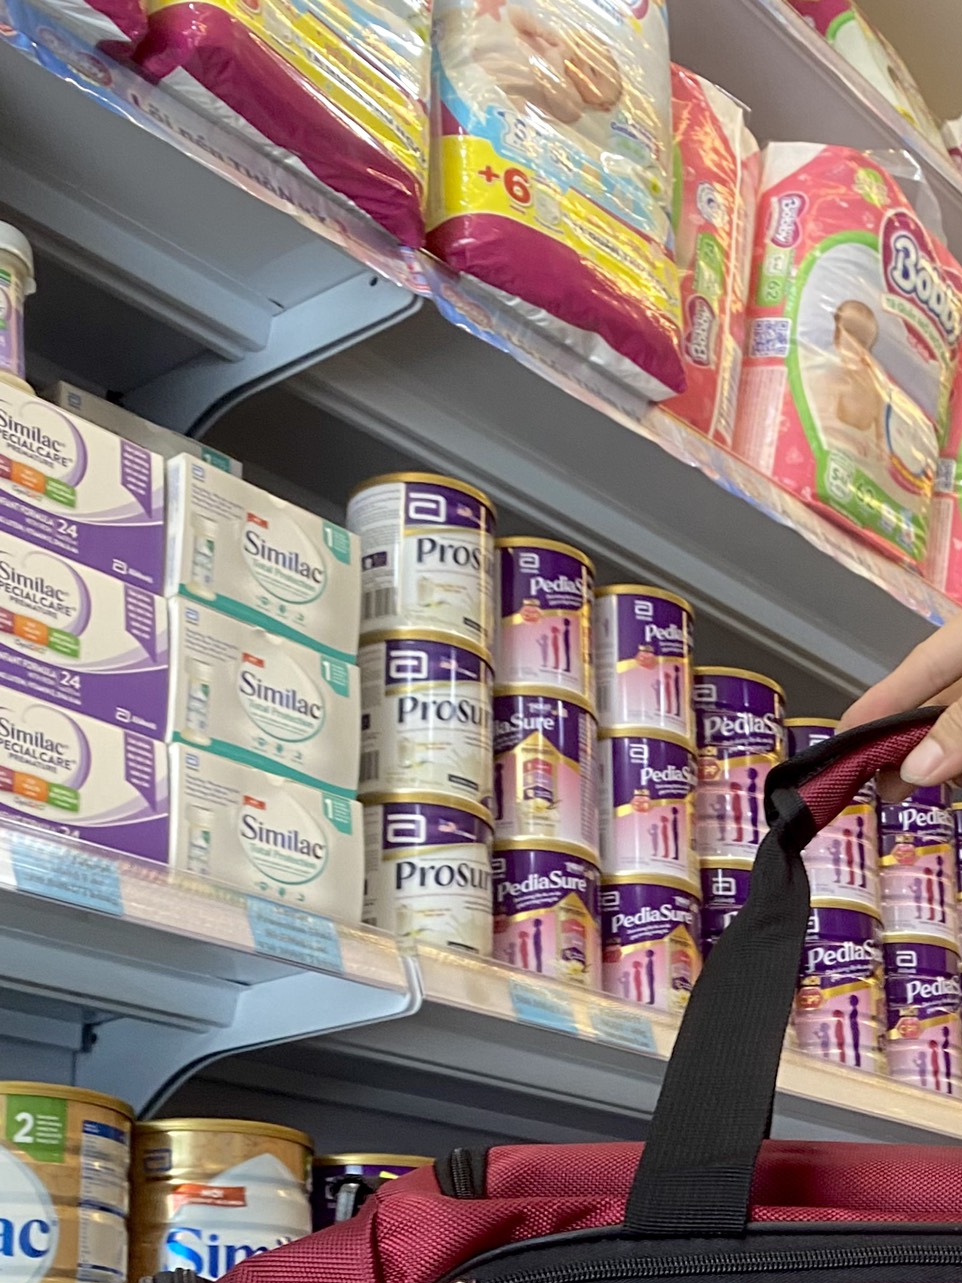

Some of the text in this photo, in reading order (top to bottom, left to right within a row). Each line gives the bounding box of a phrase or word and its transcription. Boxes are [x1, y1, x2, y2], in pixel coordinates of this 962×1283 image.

[243, 530, 323, 584] Similac
[239, 670, 321, 720] Similac
[241, 813, 324, 860] Similac
[497, 870, 588, 903] PediaSure
[611, 903, 695, 934] PediaSure
[13, 1112, 35, 1144] 2
